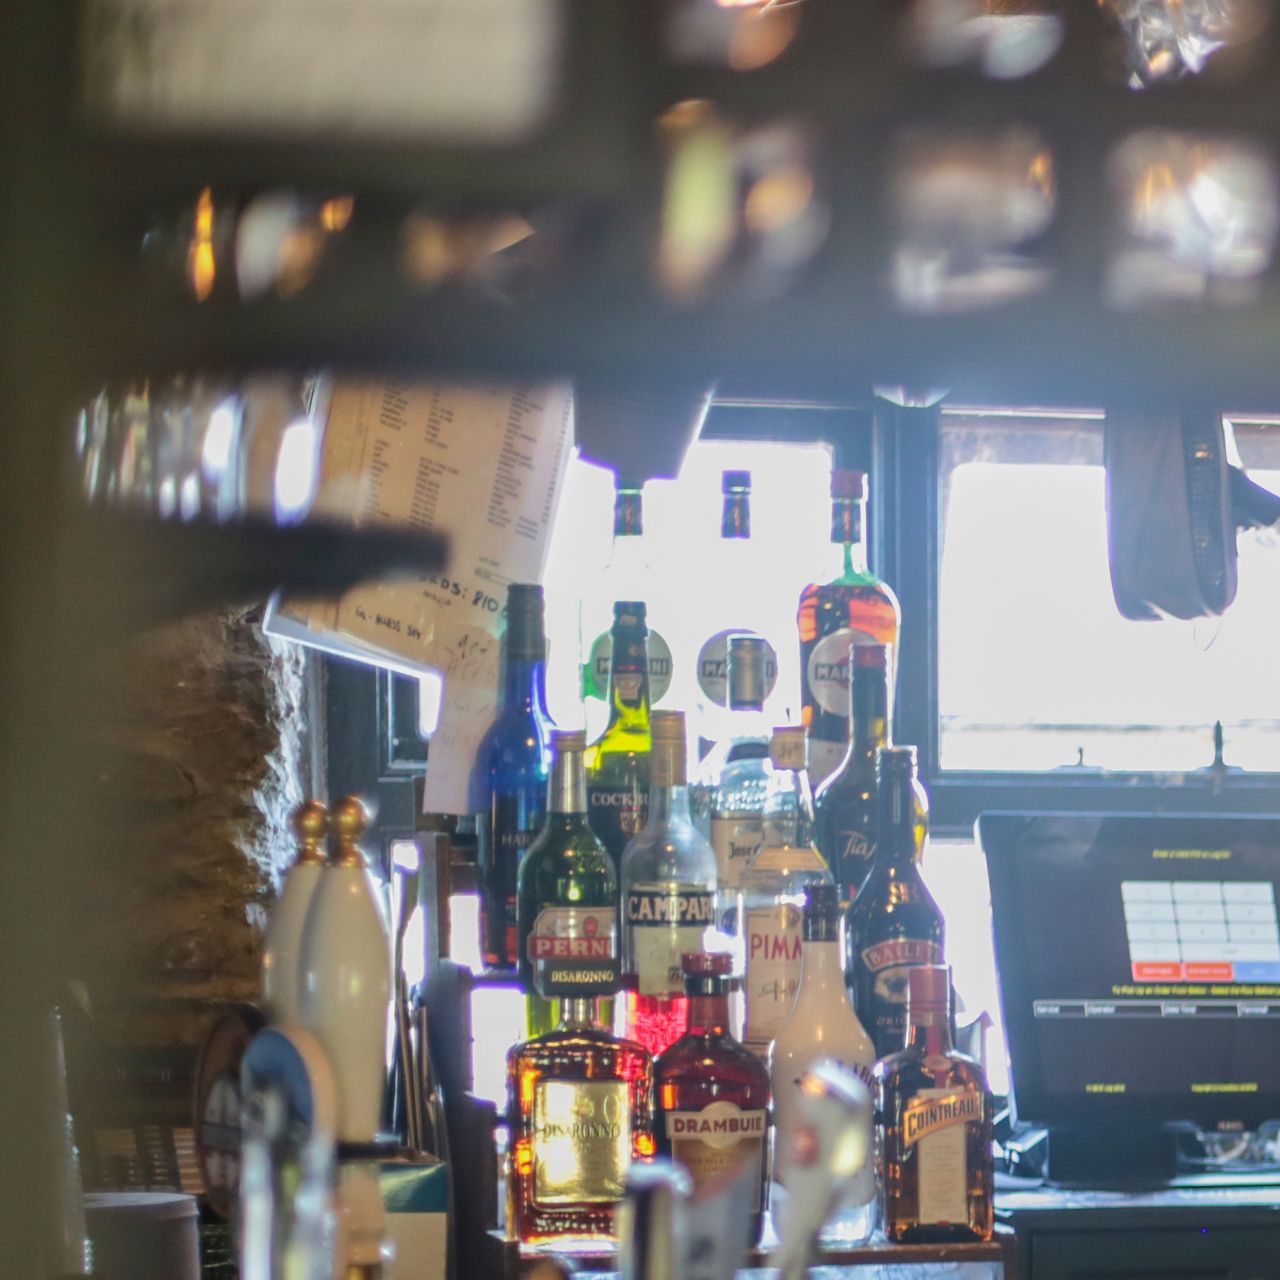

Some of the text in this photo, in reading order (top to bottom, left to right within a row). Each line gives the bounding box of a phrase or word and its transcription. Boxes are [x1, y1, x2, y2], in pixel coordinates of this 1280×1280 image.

[551, 969, 614, 984] DISARONNO
[673, 1116, 762, 1133] DRAMBUIE
[908, 1098, 975, 1137] COINTREAU
